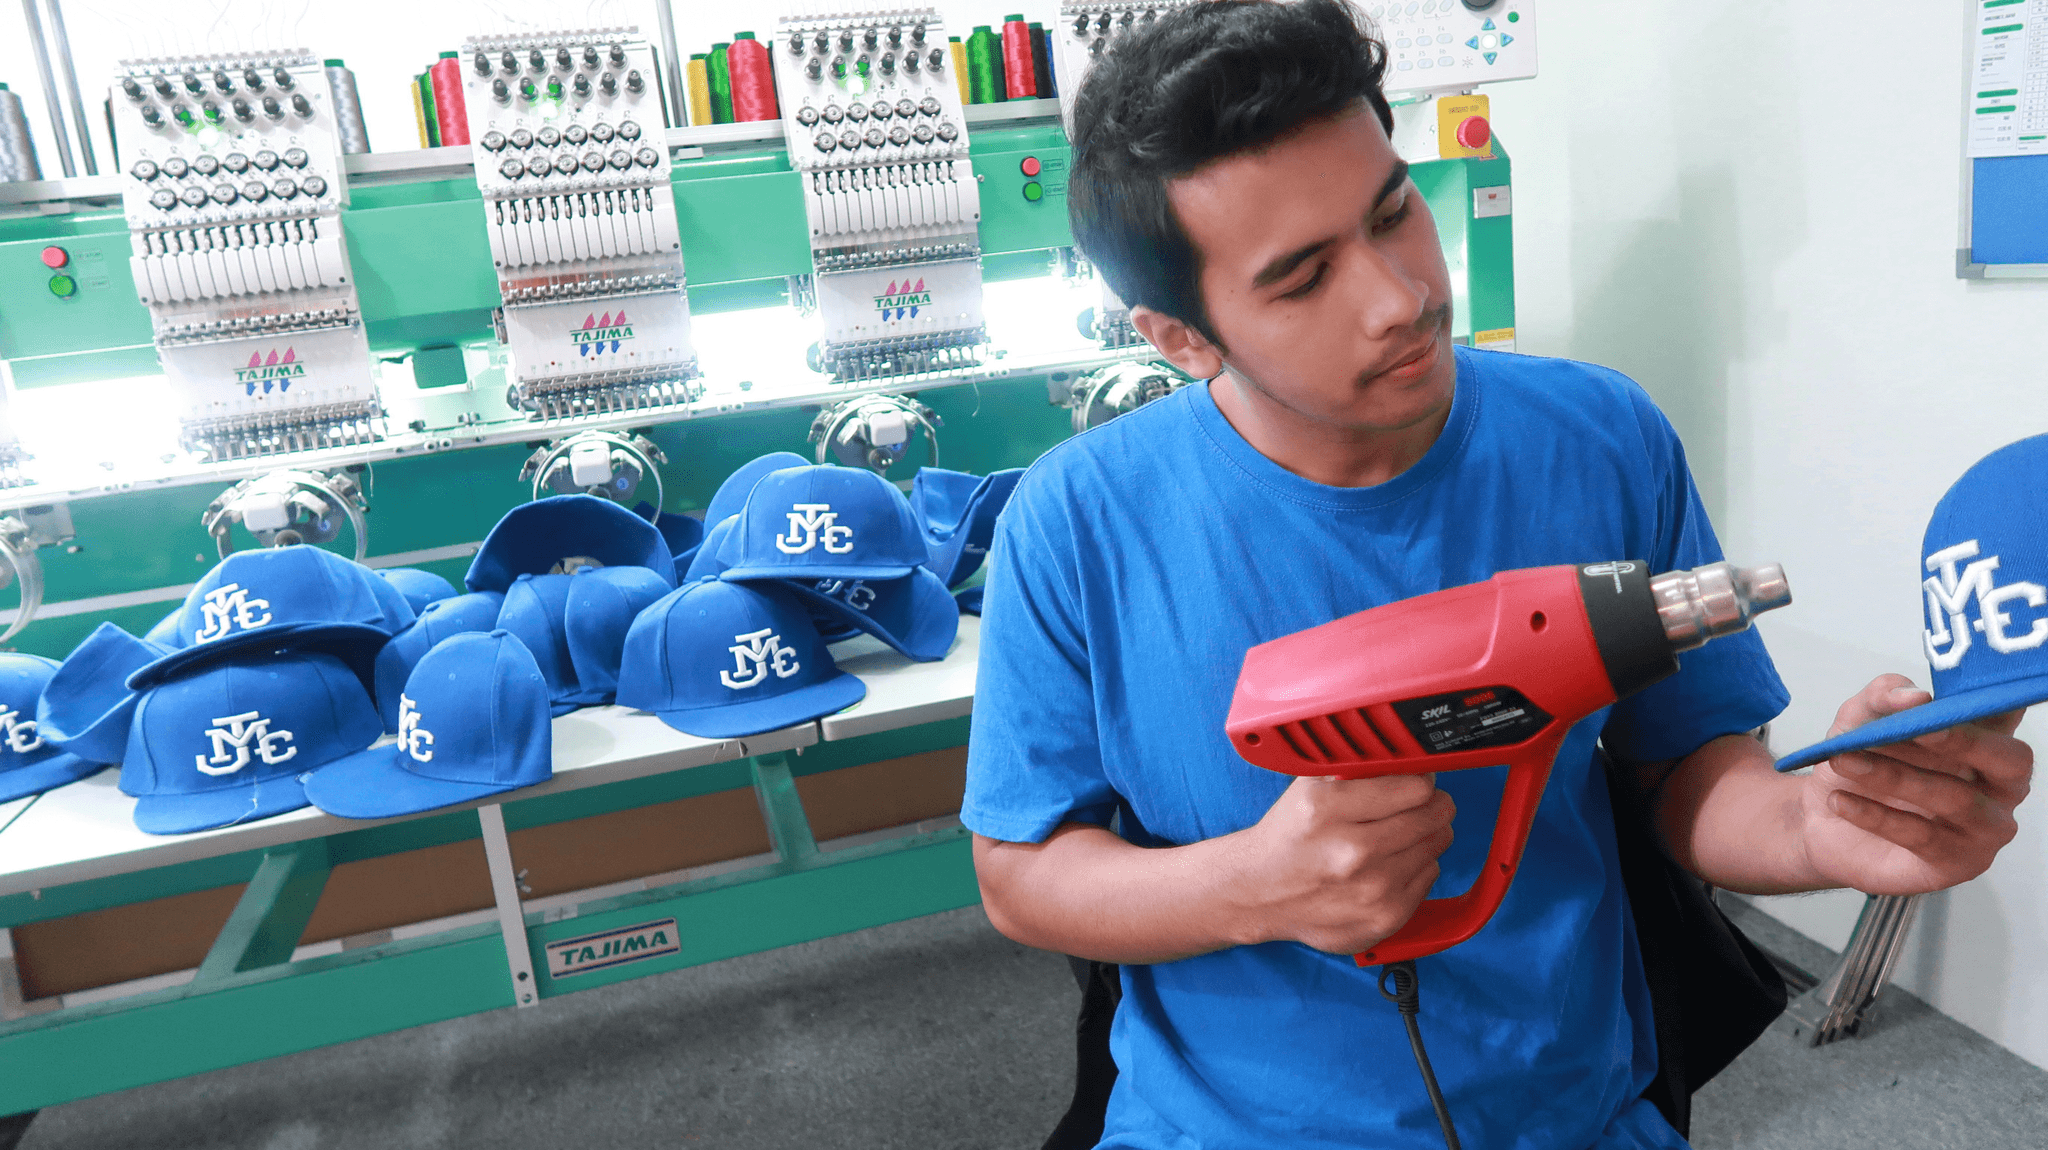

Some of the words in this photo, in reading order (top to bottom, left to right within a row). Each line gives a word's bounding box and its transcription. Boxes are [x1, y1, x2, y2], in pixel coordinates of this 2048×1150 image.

[874, 293, 931, 308] TAJIMA
[571, 327, 633, 342] TAJIMA
[235, 364, 304, 381] TAJIMA
[1421, 704, 1451, 720] SKIL
[560, 930, 668, 966] TAJIMA
